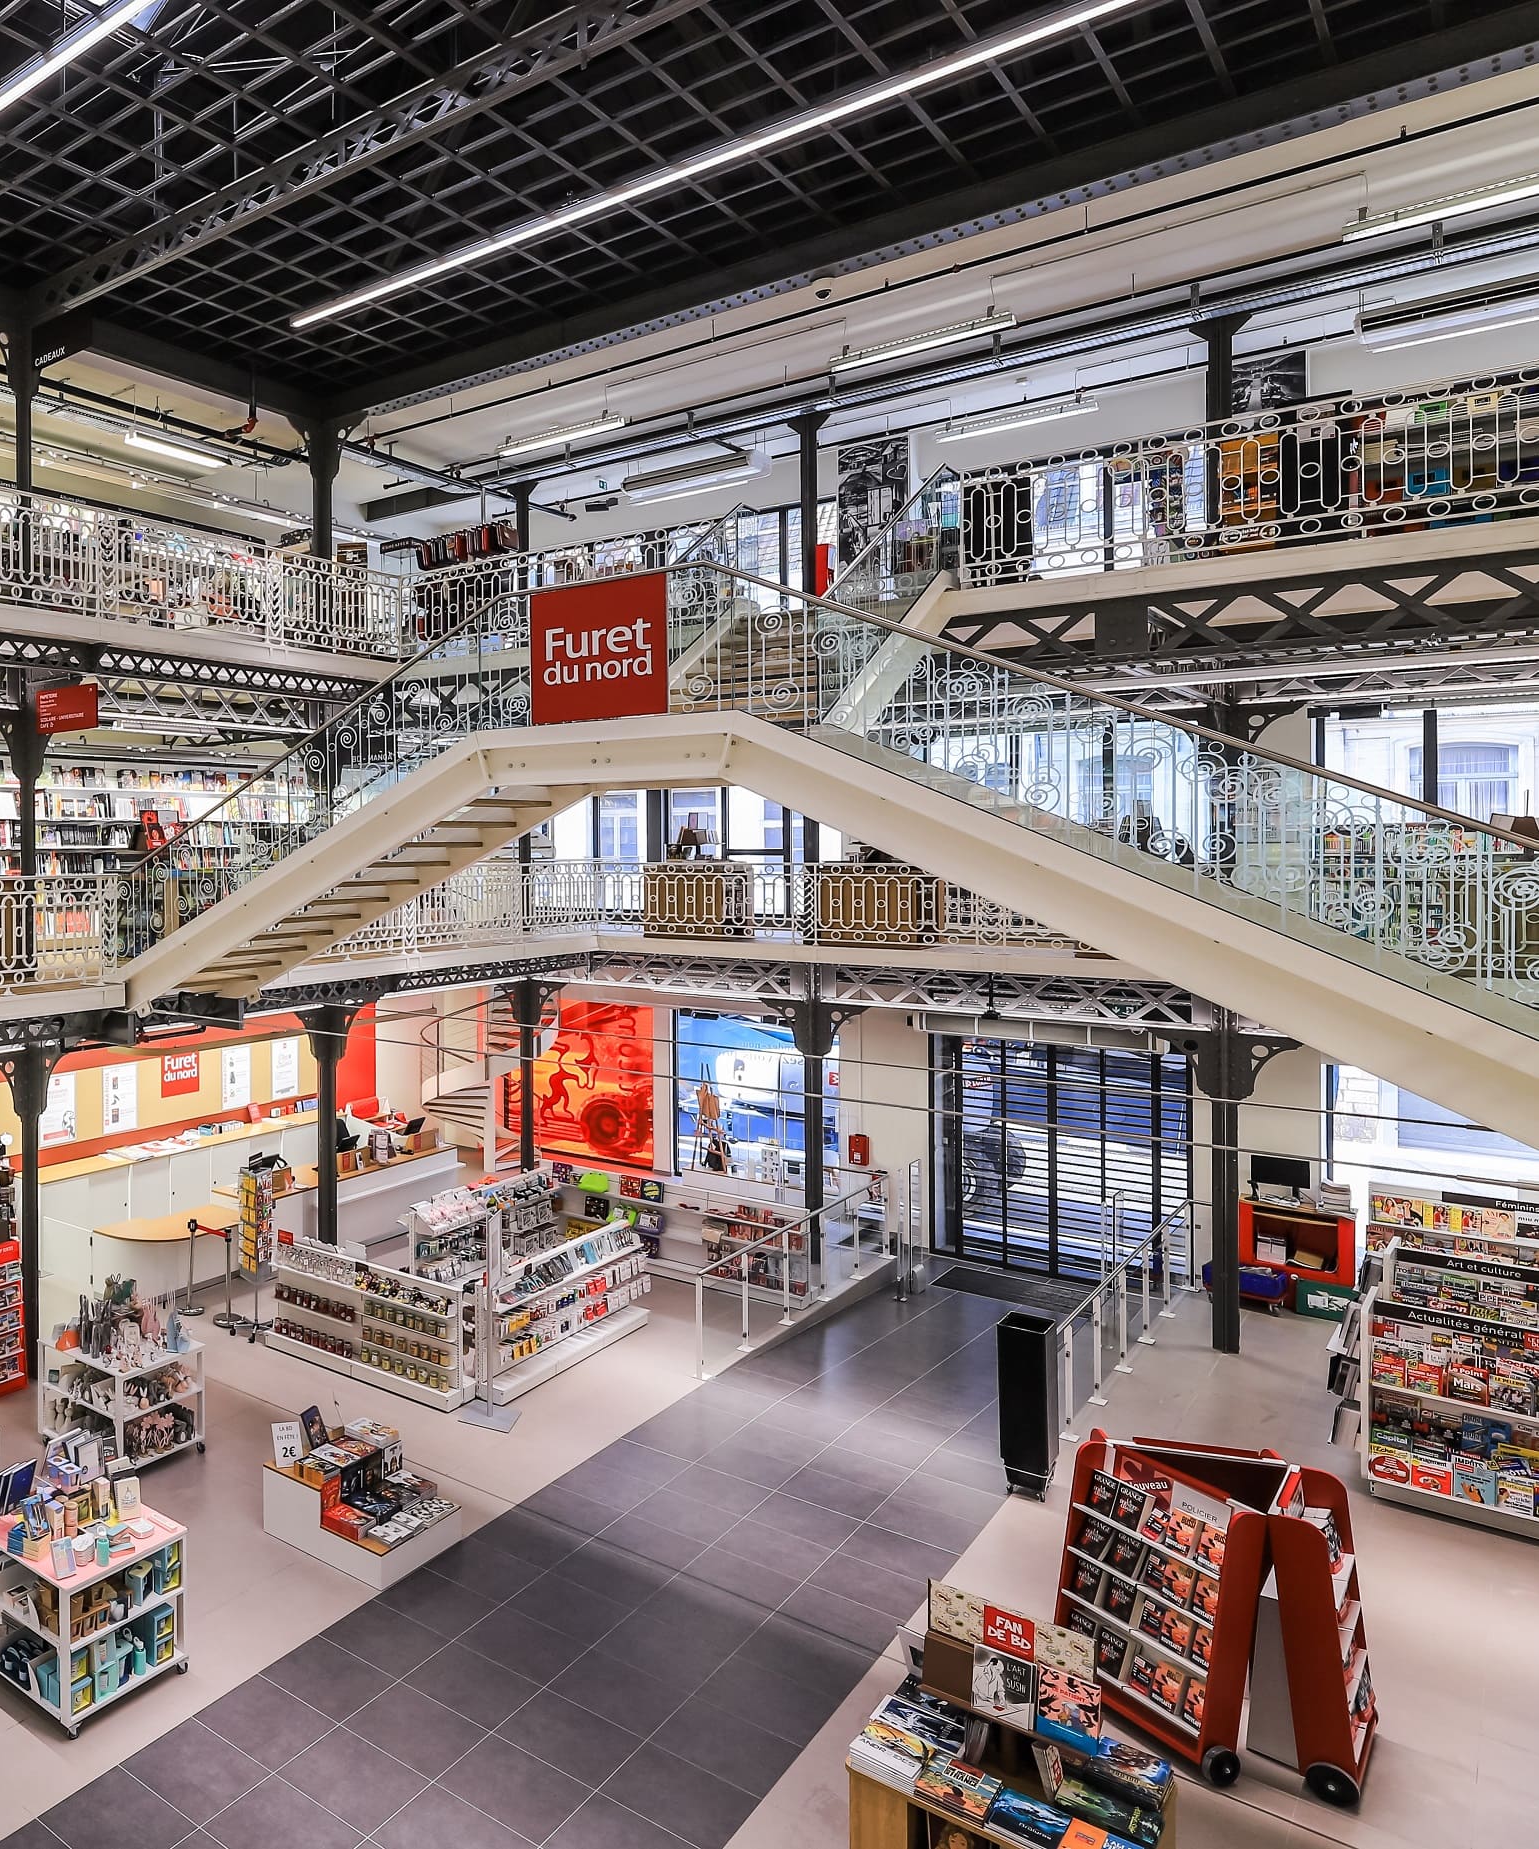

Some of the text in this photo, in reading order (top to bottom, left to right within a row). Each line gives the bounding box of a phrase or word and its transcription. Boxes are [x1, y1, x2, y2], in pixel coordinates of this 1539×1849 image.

[35, 346, 65, 366] CADEAUX
[545, 618, 651, 661] Furet
[543, 650, 653, 685] du nord
[164, 1052, 197, 1071] Furet
[164, 1067, 197, 1082] du nord
[1495, 1200, 1539, 1213] Féminins
[1447, 1259, 1522, 1278] Art et culture
[1429, 1300, 1468, 1314] Canon
[1408, 1311, 1470, 1330] Actualités
[1459, 1366, 1483, 1378] Point
[1453, 1377, 1482, 1392] Mars
[1376, 1432, 1408, 1444] Capital
[282, 1446, 296, 1458] 2€
[1413, 1454, 1446, 1467] Management
[1182, 1501, 1218, 1522] POLICIER
[1181, 1516, 1197, 1528] BUSSI
[996, 1616, 1022, 1635] FAN
[987, 1625, 1031, 1650] DE BD
[1006, 1663, 1026, 1677] L'ART
[1006, 1678, 1026, 1694] SUSHI
[1060, 1689, 1086, 1702] PATIENT
